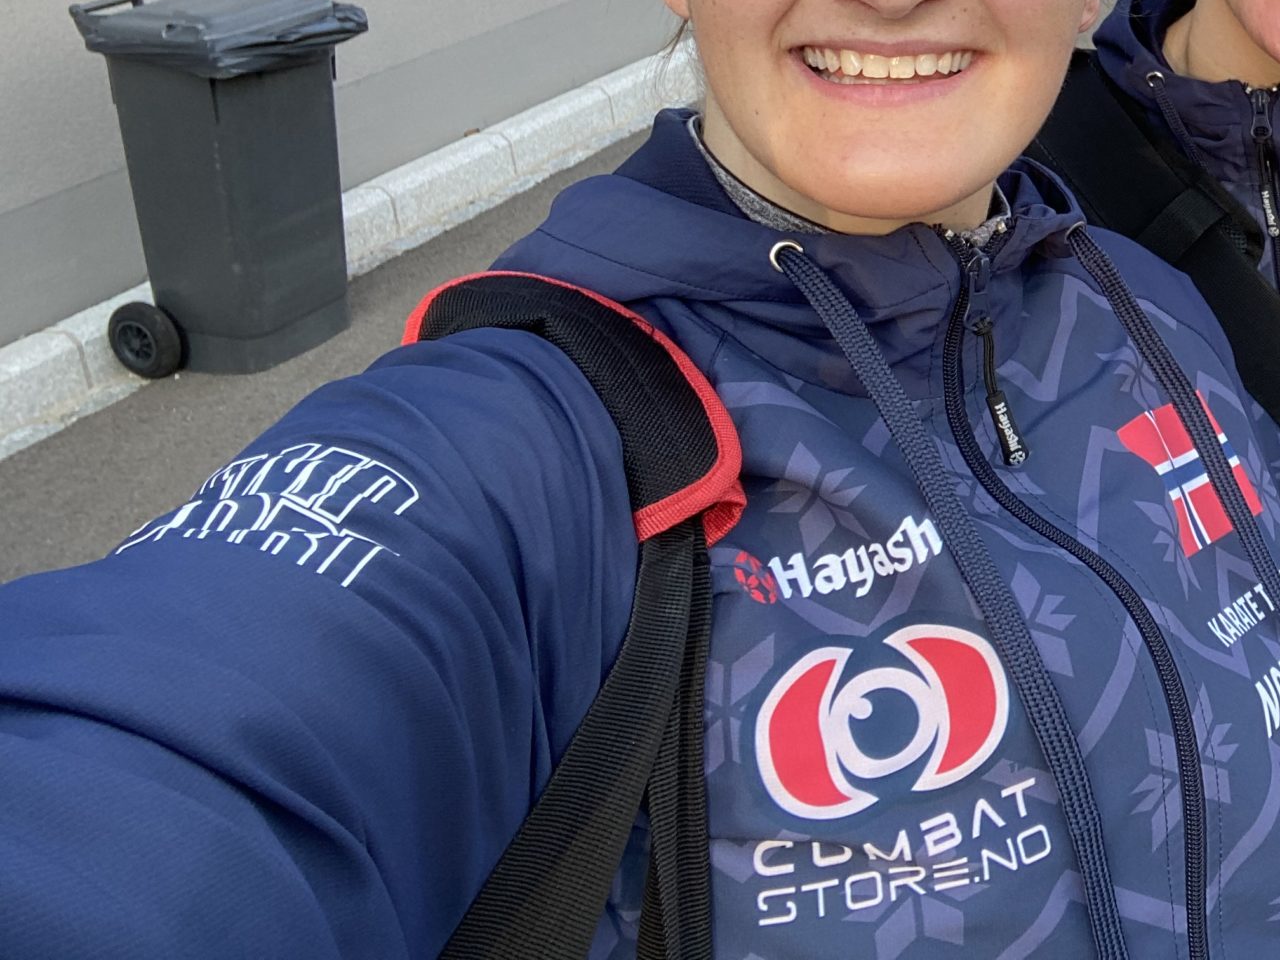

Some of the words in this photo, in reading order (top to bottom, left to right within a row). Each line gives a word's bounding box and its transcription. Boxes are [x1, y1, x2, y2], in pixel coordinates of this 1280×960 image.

[767, 515, 943, 599] Hayash
[1207, 590, 1266, 648] KARATE
[752, 777, 1036, 877] COMBAT
[756, 824, 1052, 927] STORE.NO
